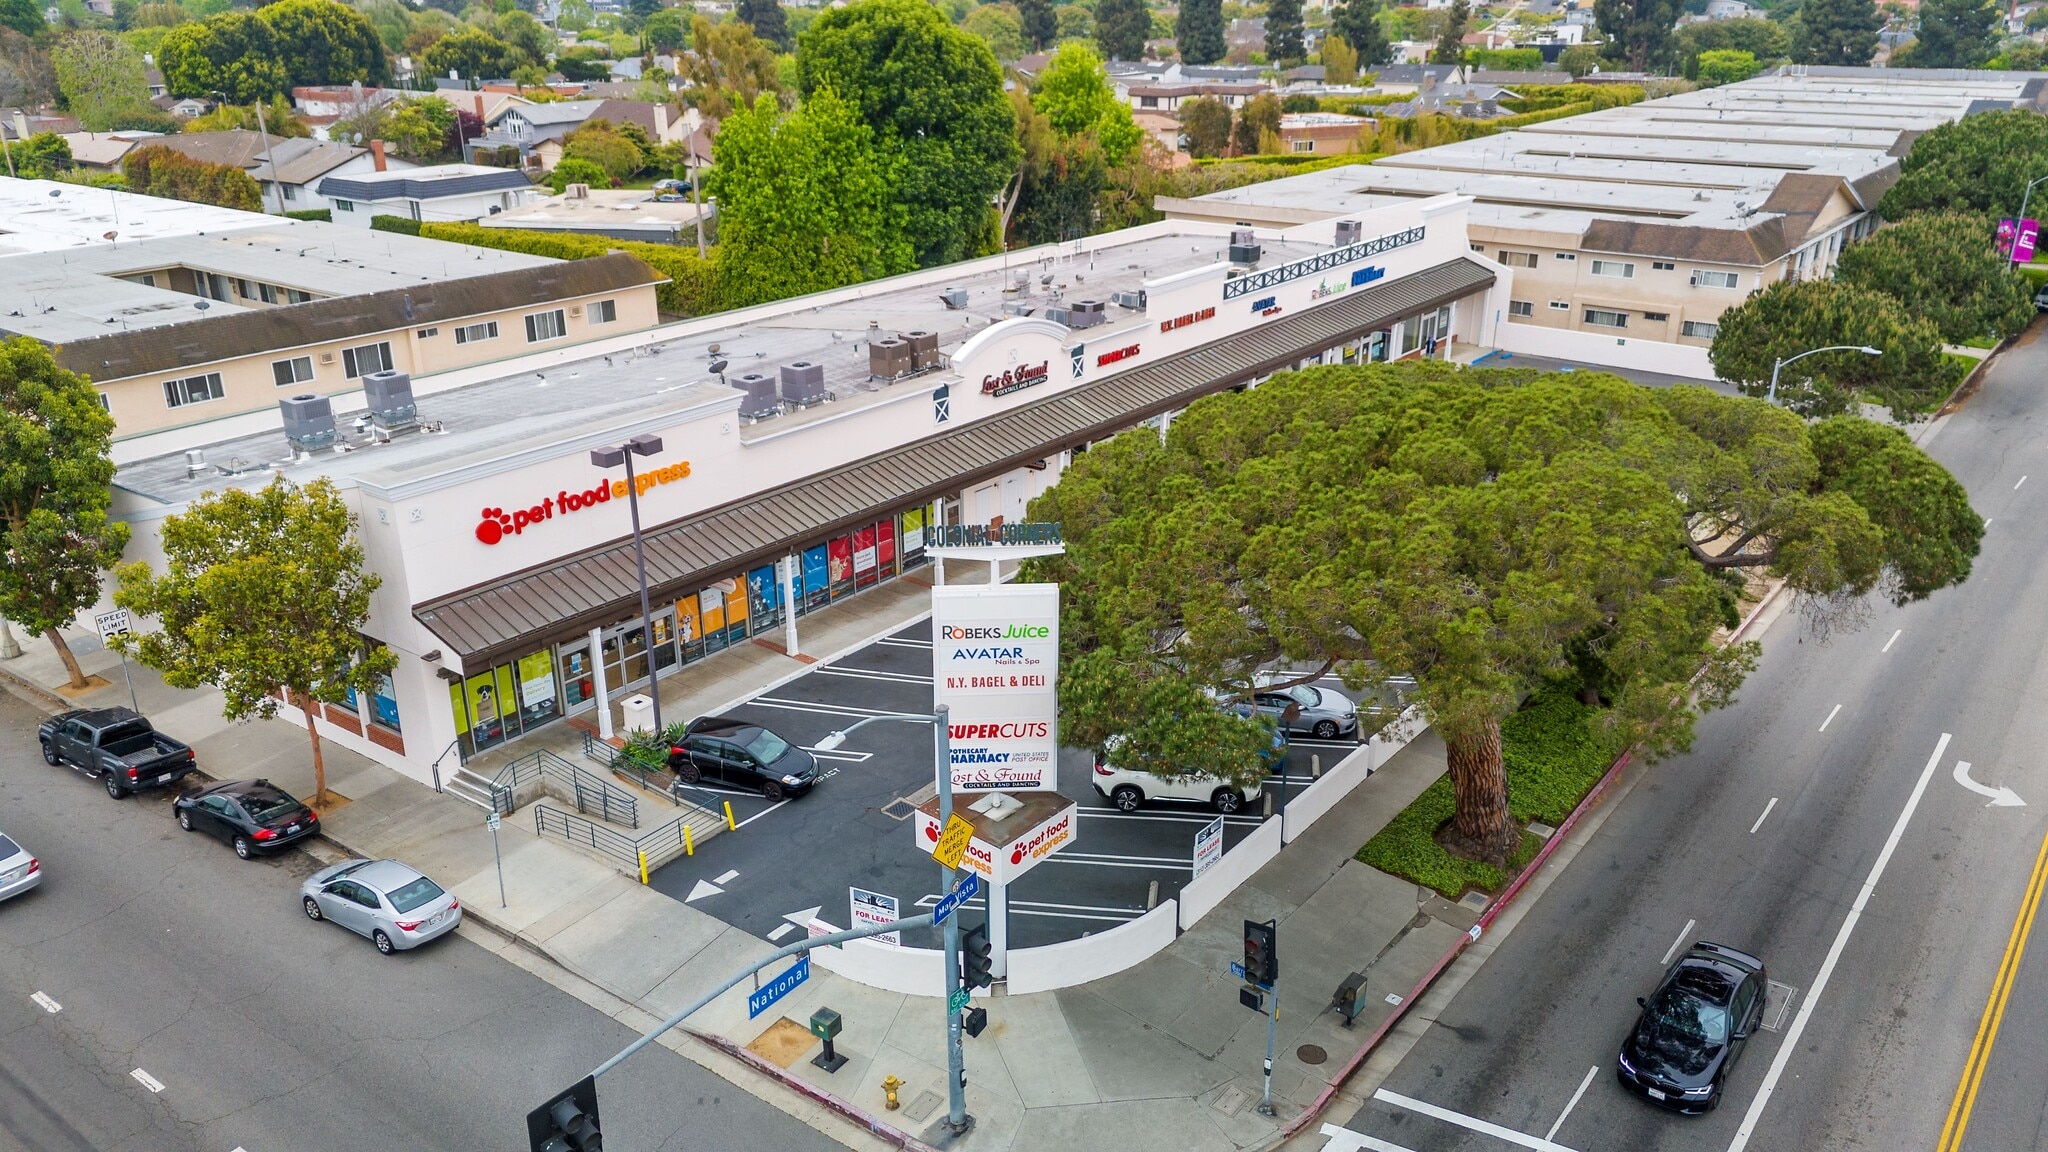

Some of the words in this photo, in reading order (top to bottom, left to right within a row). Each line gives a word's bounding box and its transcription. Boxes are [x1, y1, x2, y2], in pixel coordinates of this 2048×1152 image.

[979, 375, 1000, 395] Lost
[1001, 370, 1014, 386] &
[1014, 360, 1048, 381] Found
[513, 497, 554, 535] pet
[556, 478, 611, 514] food
[927, 524, 992, 547] COLONIAL
[1000, 521, 1062, 546] CORNERS
[98, 611, 127, 624] SPEED
[102, 620, 126, 631] LIMIT
[942, 625, 1001, 640] ROBEKS
[1002, 624, 1049, 639] Juice
[952, 647, 1023, 660] AVATAR
[1025, 658, 1040, 666] Spa
[947, 677, 967, 689] N.Y.
[971, 676, 1005, 688] BAGEL
[1009, 675, 1018, 687] &
[1022, 675, 1045, 687] DELI
[949, 747, 988, 755] POTHECARY
[951, 753, 1010, 764] HARMACY
[975, 768, 990, 782] &
[994, 767, 1042, 781] Found
[946, 820, 960, 835] THRU
[1028, 831, 1045, 853] pet
[1046, 815, 1068, 838] food
[942, 826, 965, 847] TRAFFIC
[1032, 830, 1069, 858] express
[944, 838, 963, 856] MERGE
[1197, 848, 1206, 858] FOR
[1207, 837, 1220, 851] LEASE
[947, 849, 961, 864] LEFT
[938, 900, 952, 916] Mar
[955, 883, 974, 904] Vista
[855, 910, 870, 919] FOR
[751, 963, 807, 1013] National
